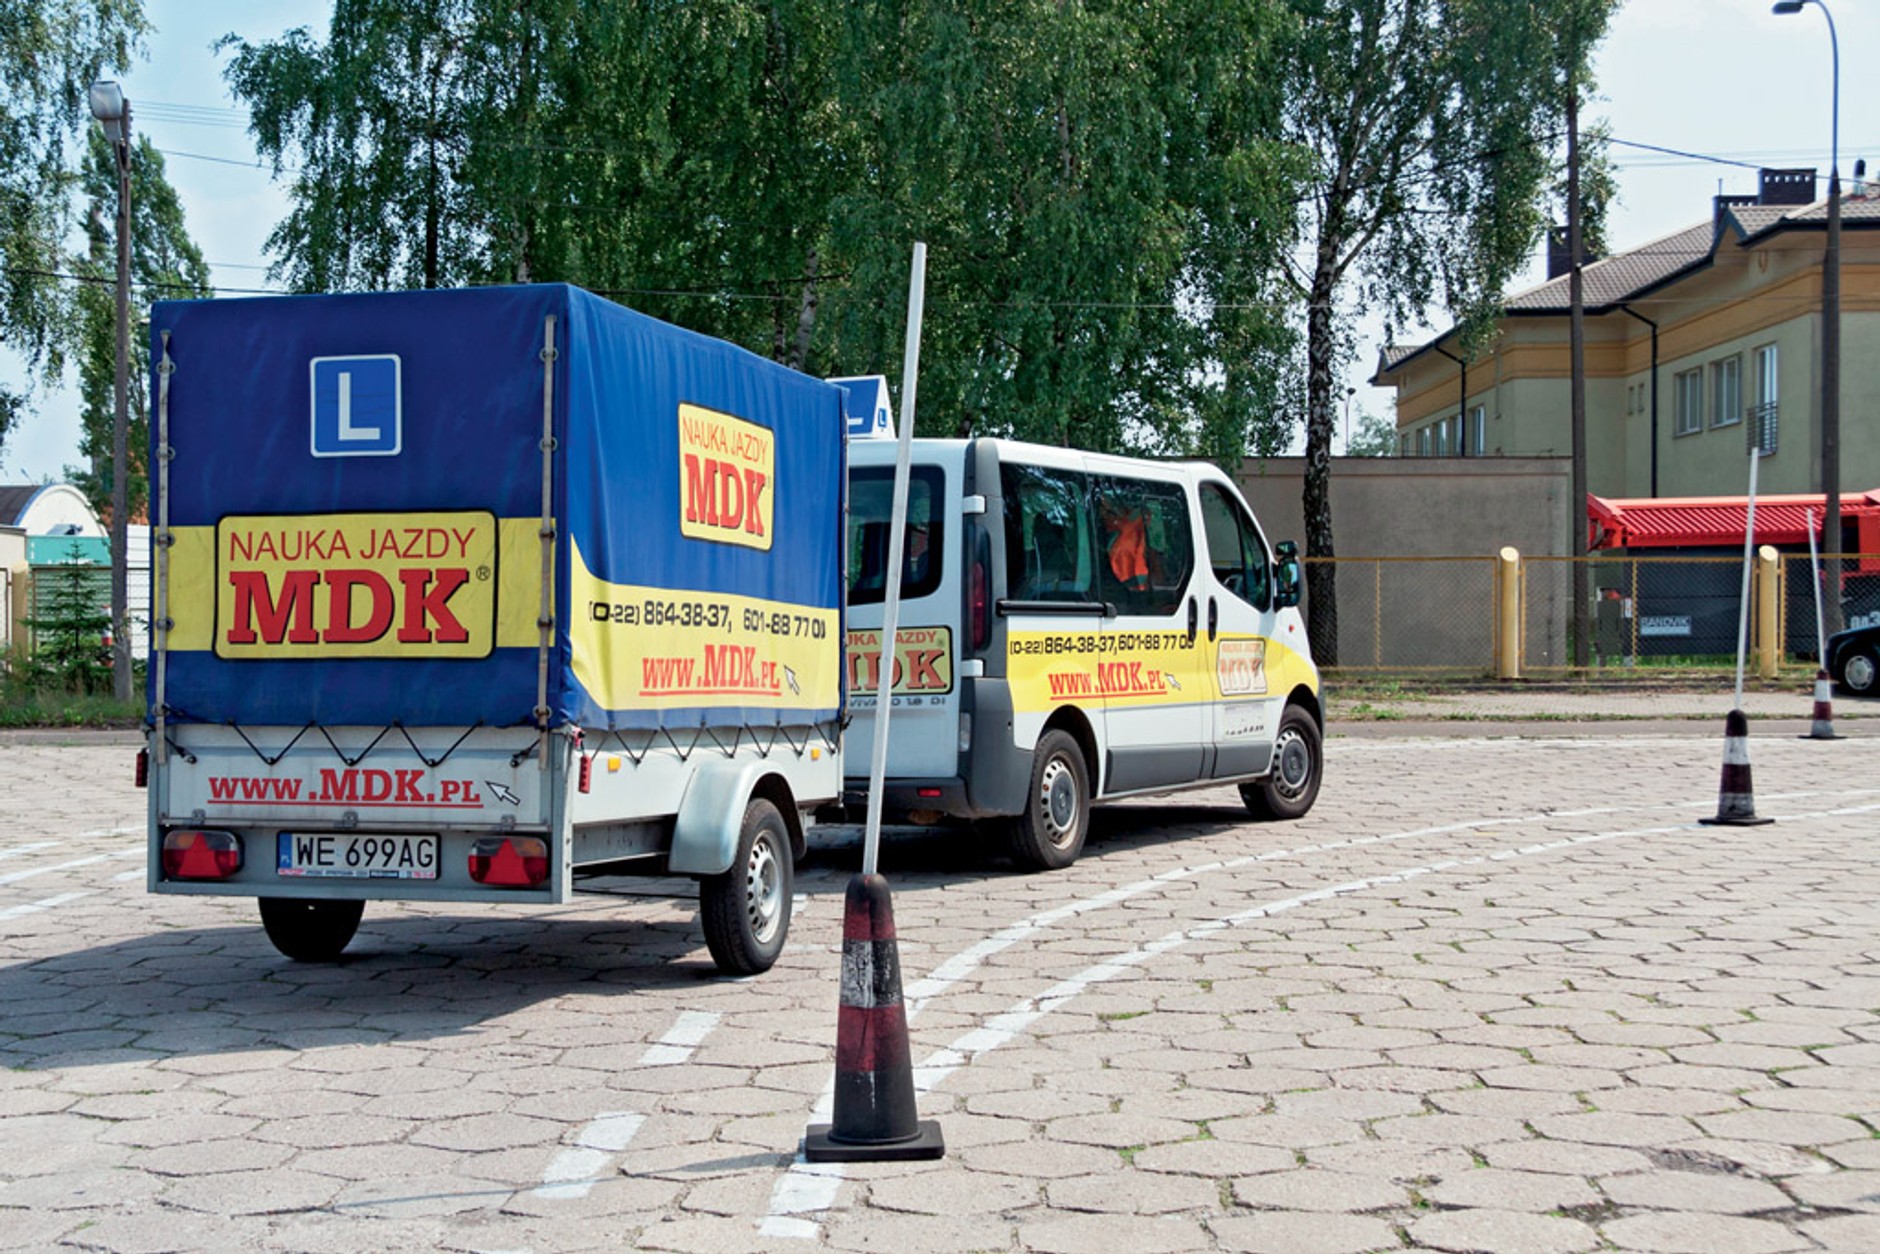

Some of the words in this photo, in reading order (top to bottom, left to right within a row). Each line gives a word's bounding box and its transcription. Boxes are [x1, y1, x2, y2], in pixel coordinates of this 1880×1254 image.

[338, 372, 381, 441] L
[683, 416, 728, 455] NAUKA
[731, 430, 768, 466] JAZDY
[684, 453, 766, 537] MDK
[230, 529, 351, 562] NAUKA
[360, 527, 476, 560] JAZDY
[227, 568, 470, 645] MDK
[896, 631, 936, 645] AZDY
[297, 837, 335, 866] WE
[345, 838, 433, 868] 699AG
